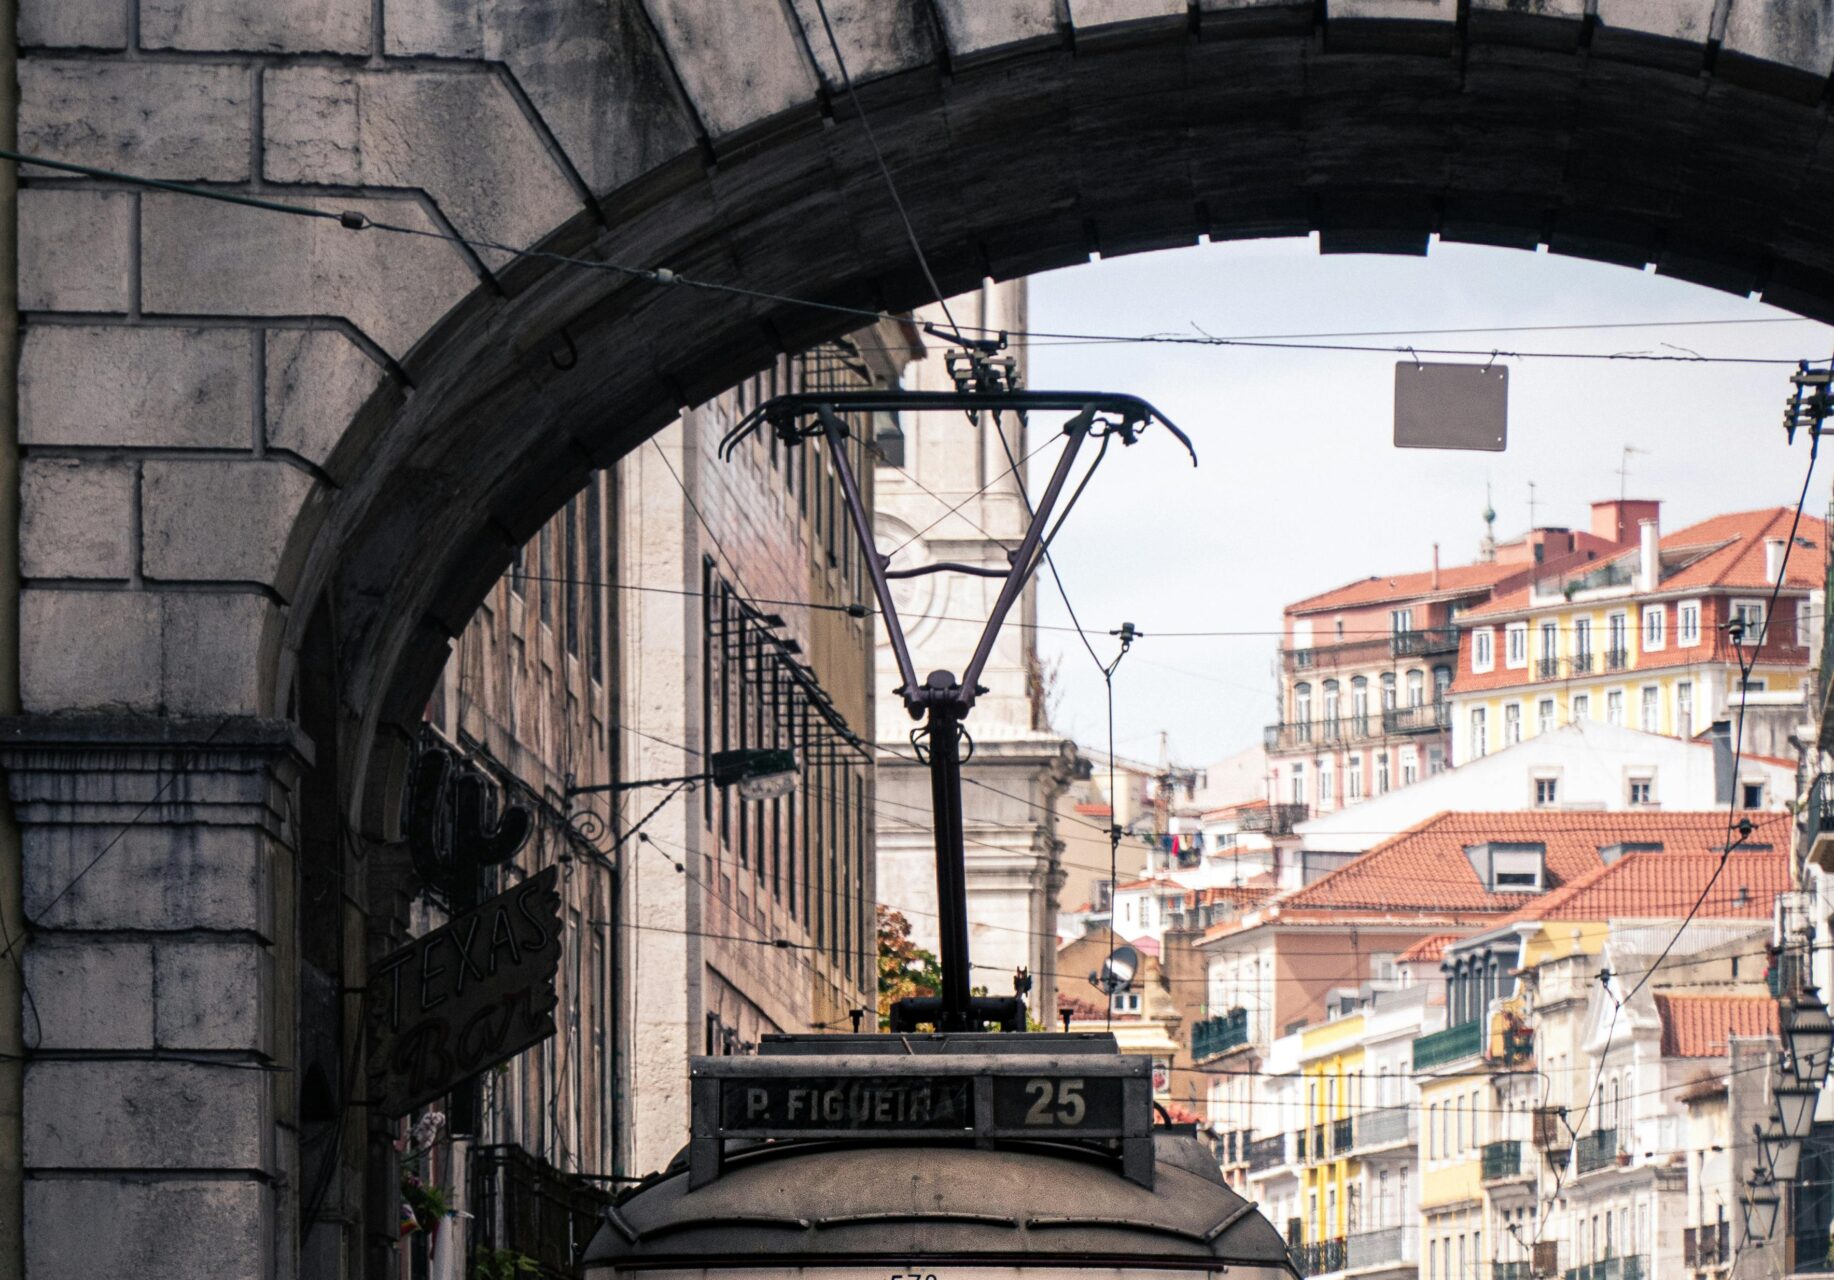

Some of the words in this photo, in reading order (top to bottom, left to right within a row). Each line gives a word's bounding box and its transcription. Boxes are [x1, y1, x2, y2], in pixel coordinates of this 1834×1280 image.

[377, 886, 548, 1034] TEXAS
[746, 1088, 771, 1121] P.
[1024, 1078, 1087, 1125] 25
